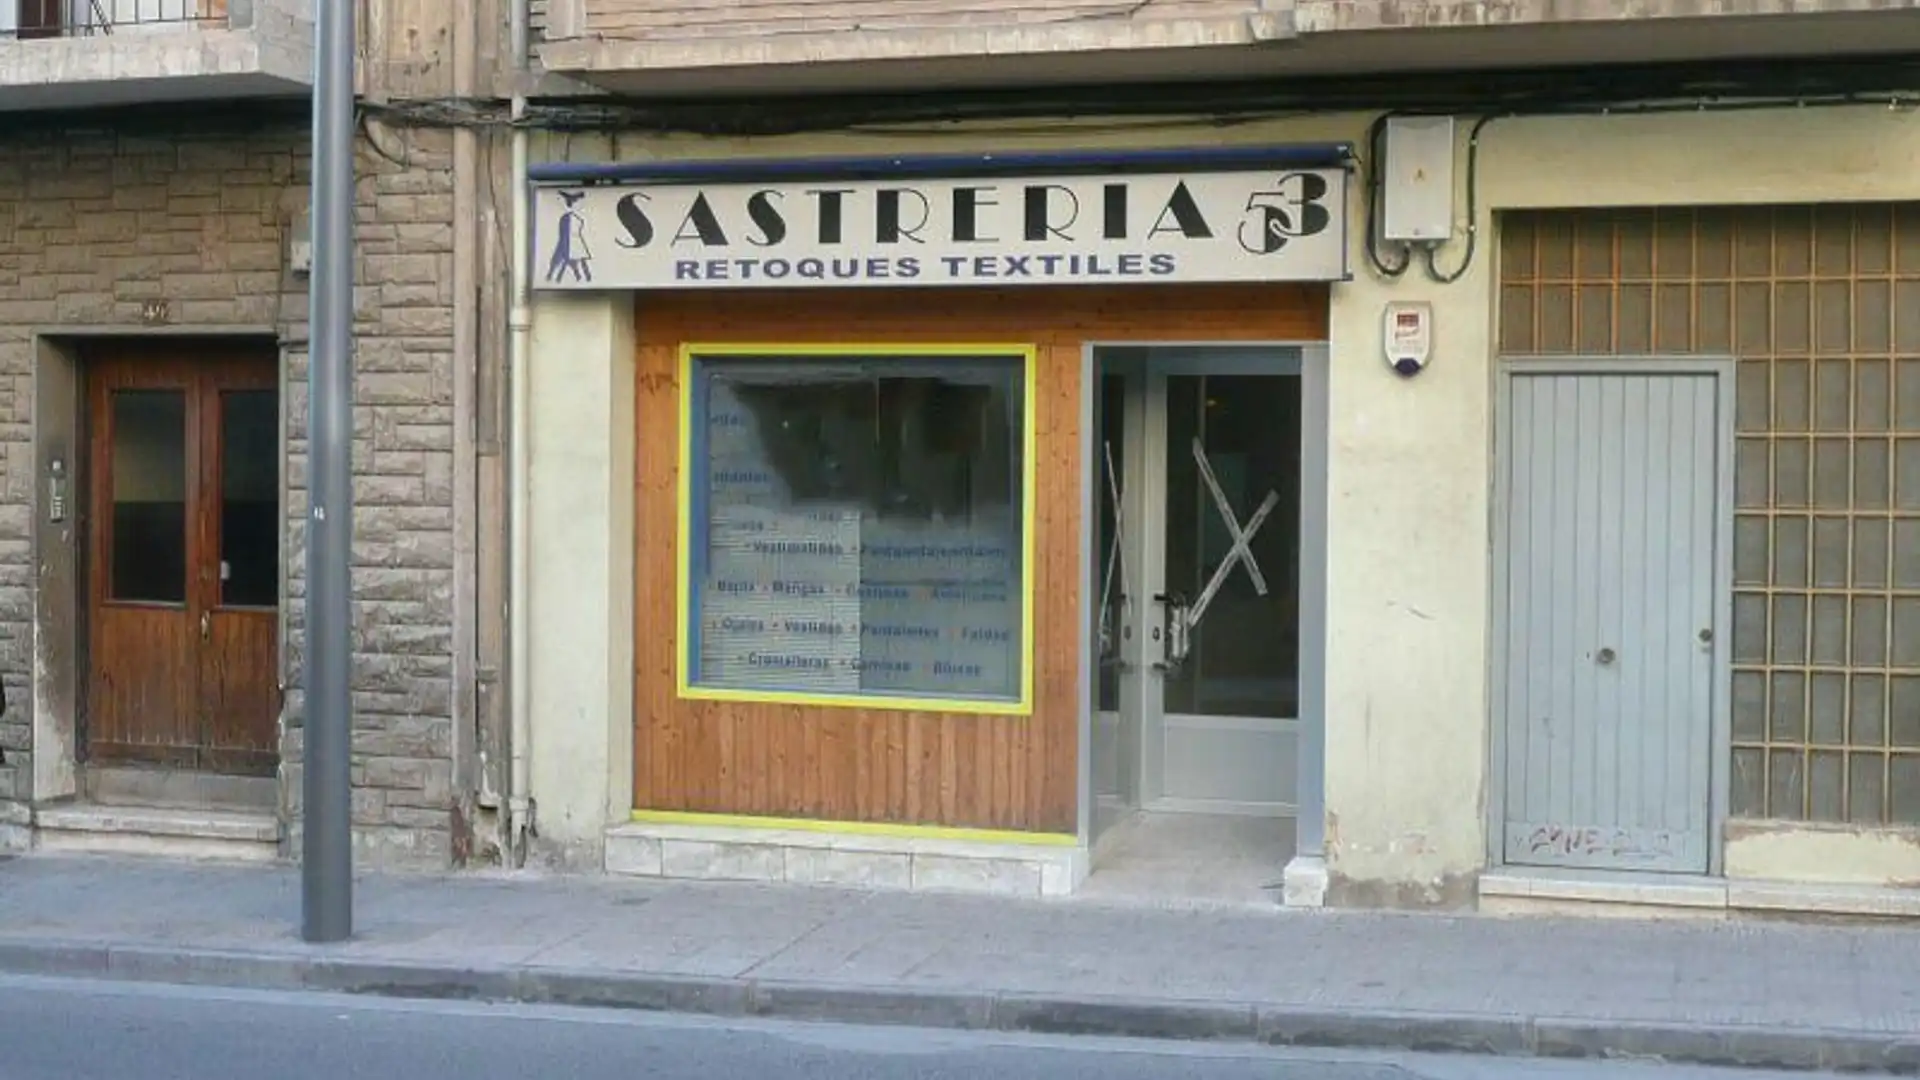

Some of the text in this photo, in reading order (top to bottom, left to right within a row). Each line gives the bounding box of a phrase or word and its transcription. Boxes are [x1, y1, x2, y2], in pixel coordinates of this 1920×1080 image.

[614, 173, 1330, 254] SASTRERIA 53
[676, 253, 1176, 279] RETOQUES TEXTILES
